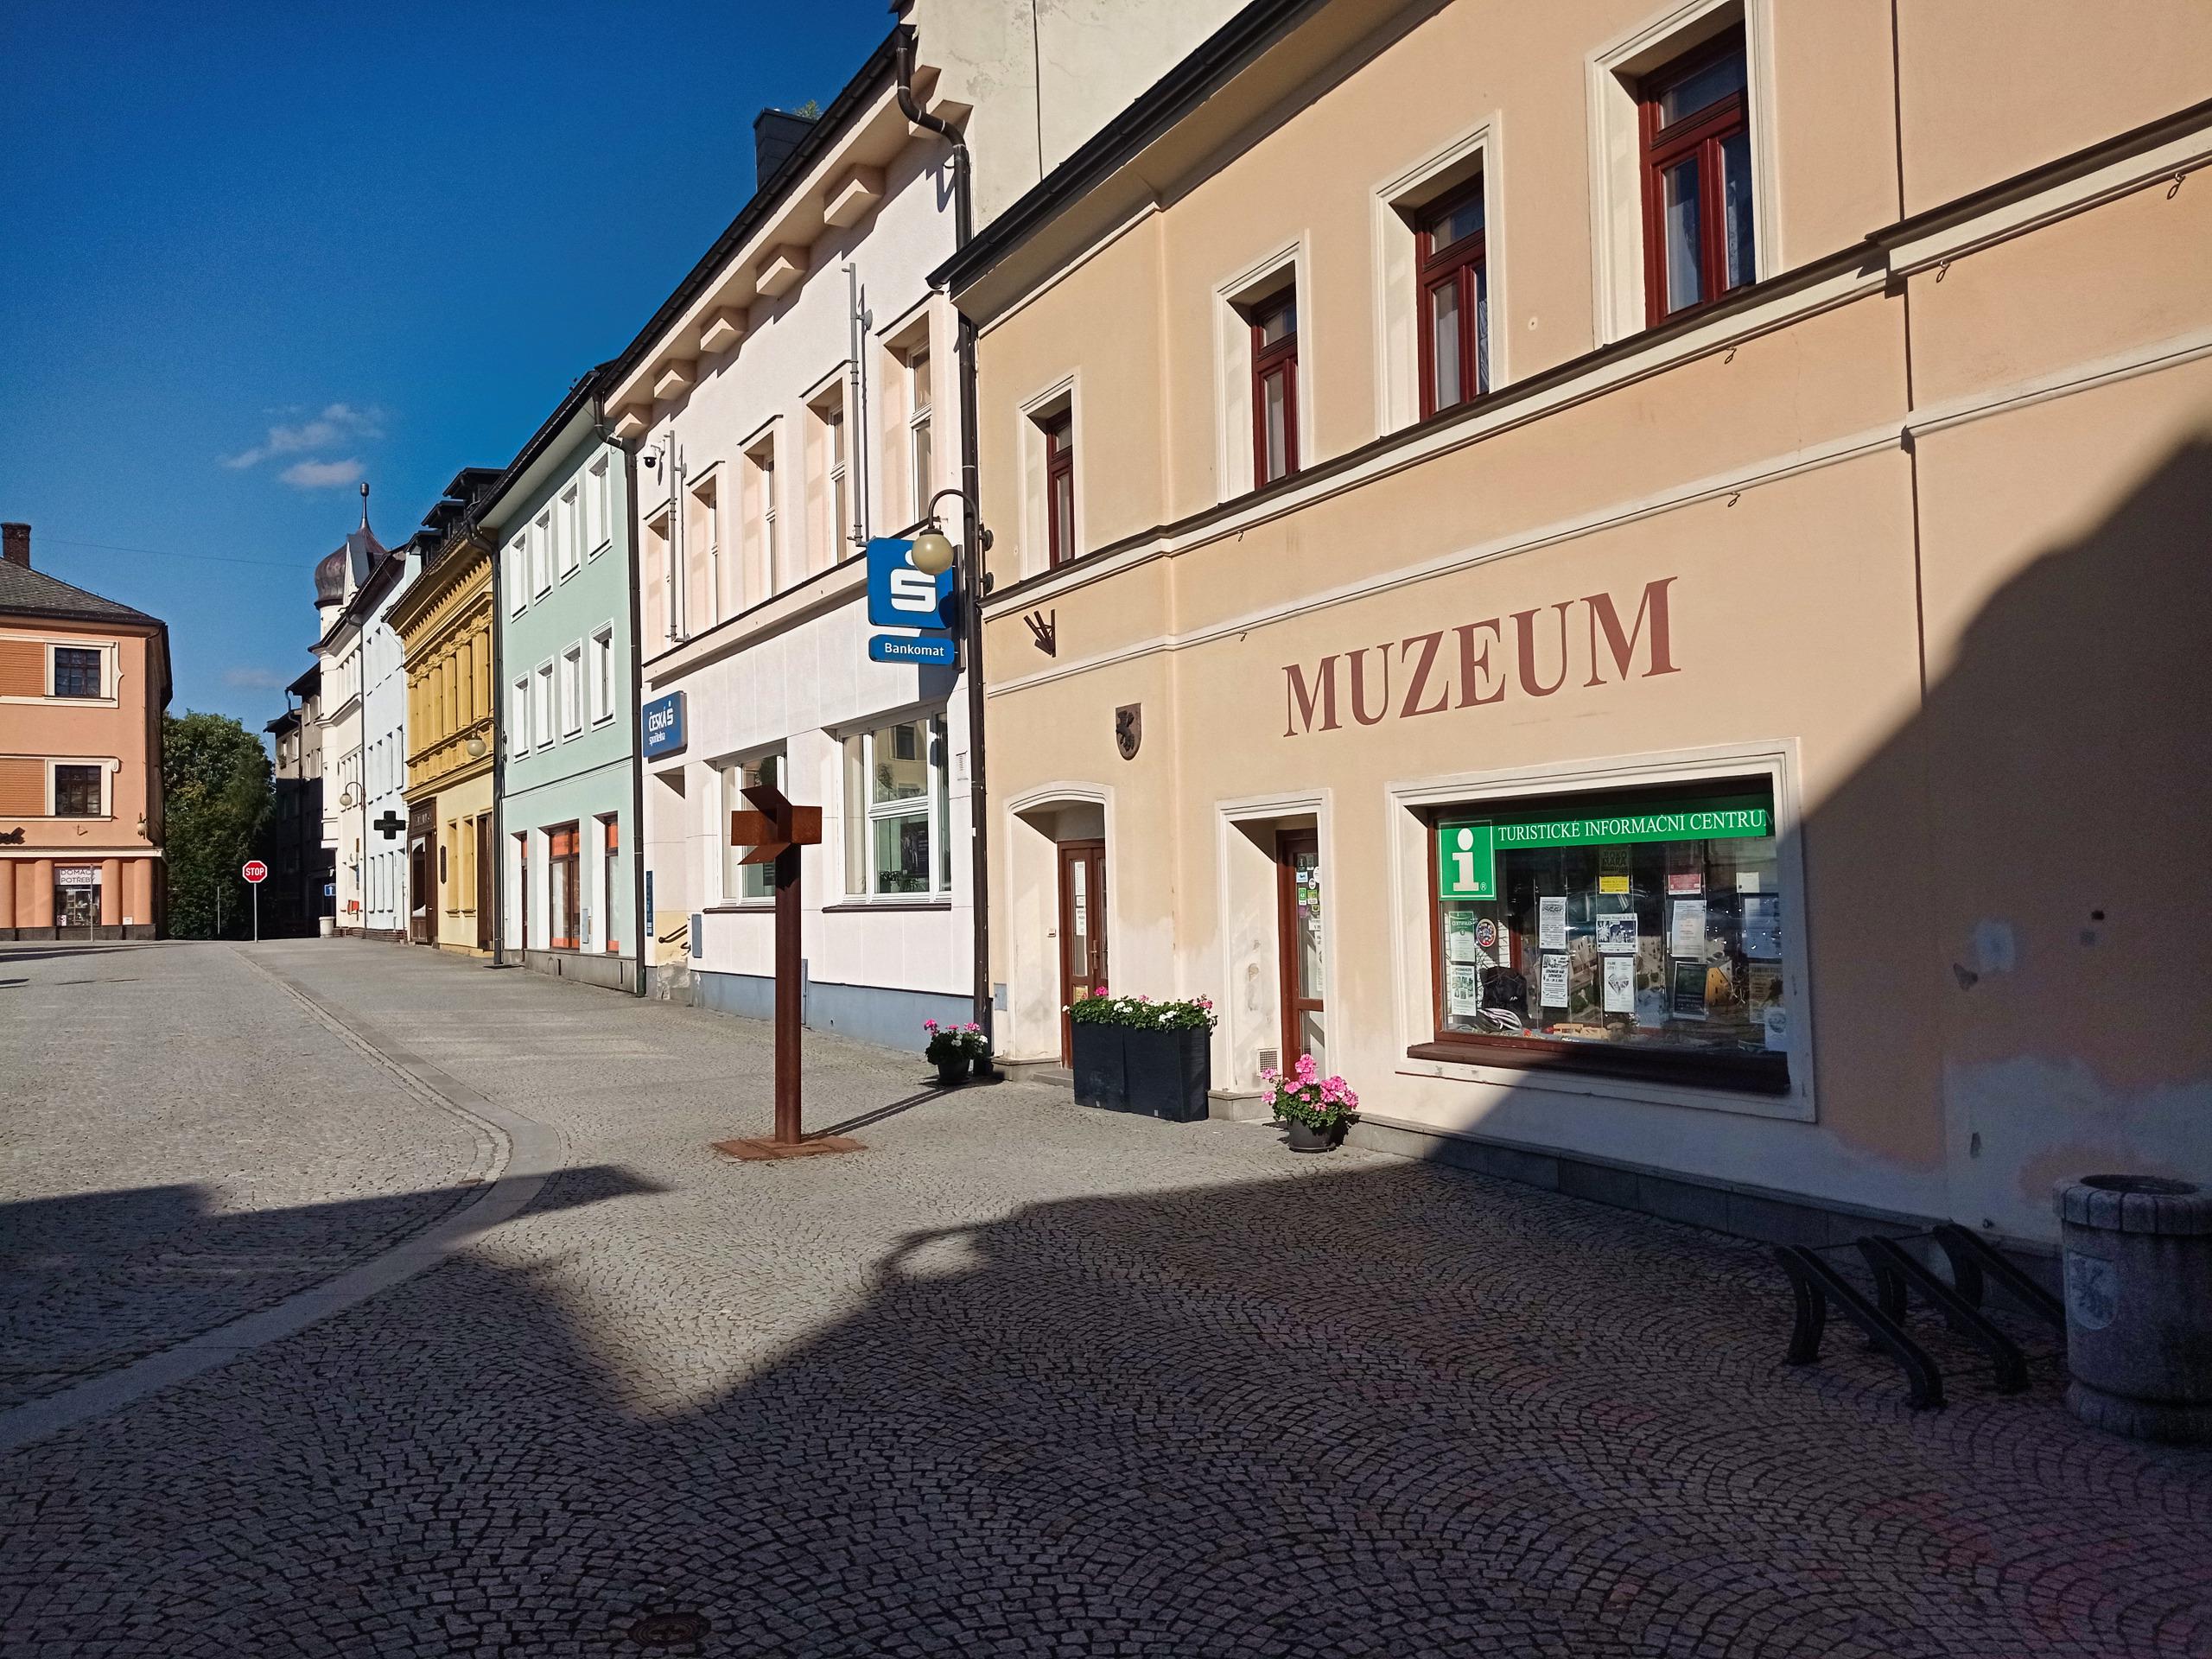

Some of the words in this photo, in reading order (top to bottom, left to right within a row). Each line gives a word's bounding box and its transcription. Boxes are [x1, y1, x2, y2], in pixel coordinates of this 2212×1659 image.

[885, 642, 944, 657] Bankomat
[1282, 576, 1681, 737] MUZEUM
[1498, 818, 1581, 841] TURISTICKÉ
[1585, 810, 1685, 836] INFORMAČNÍ
[245, 867, 264, 876] STOP
